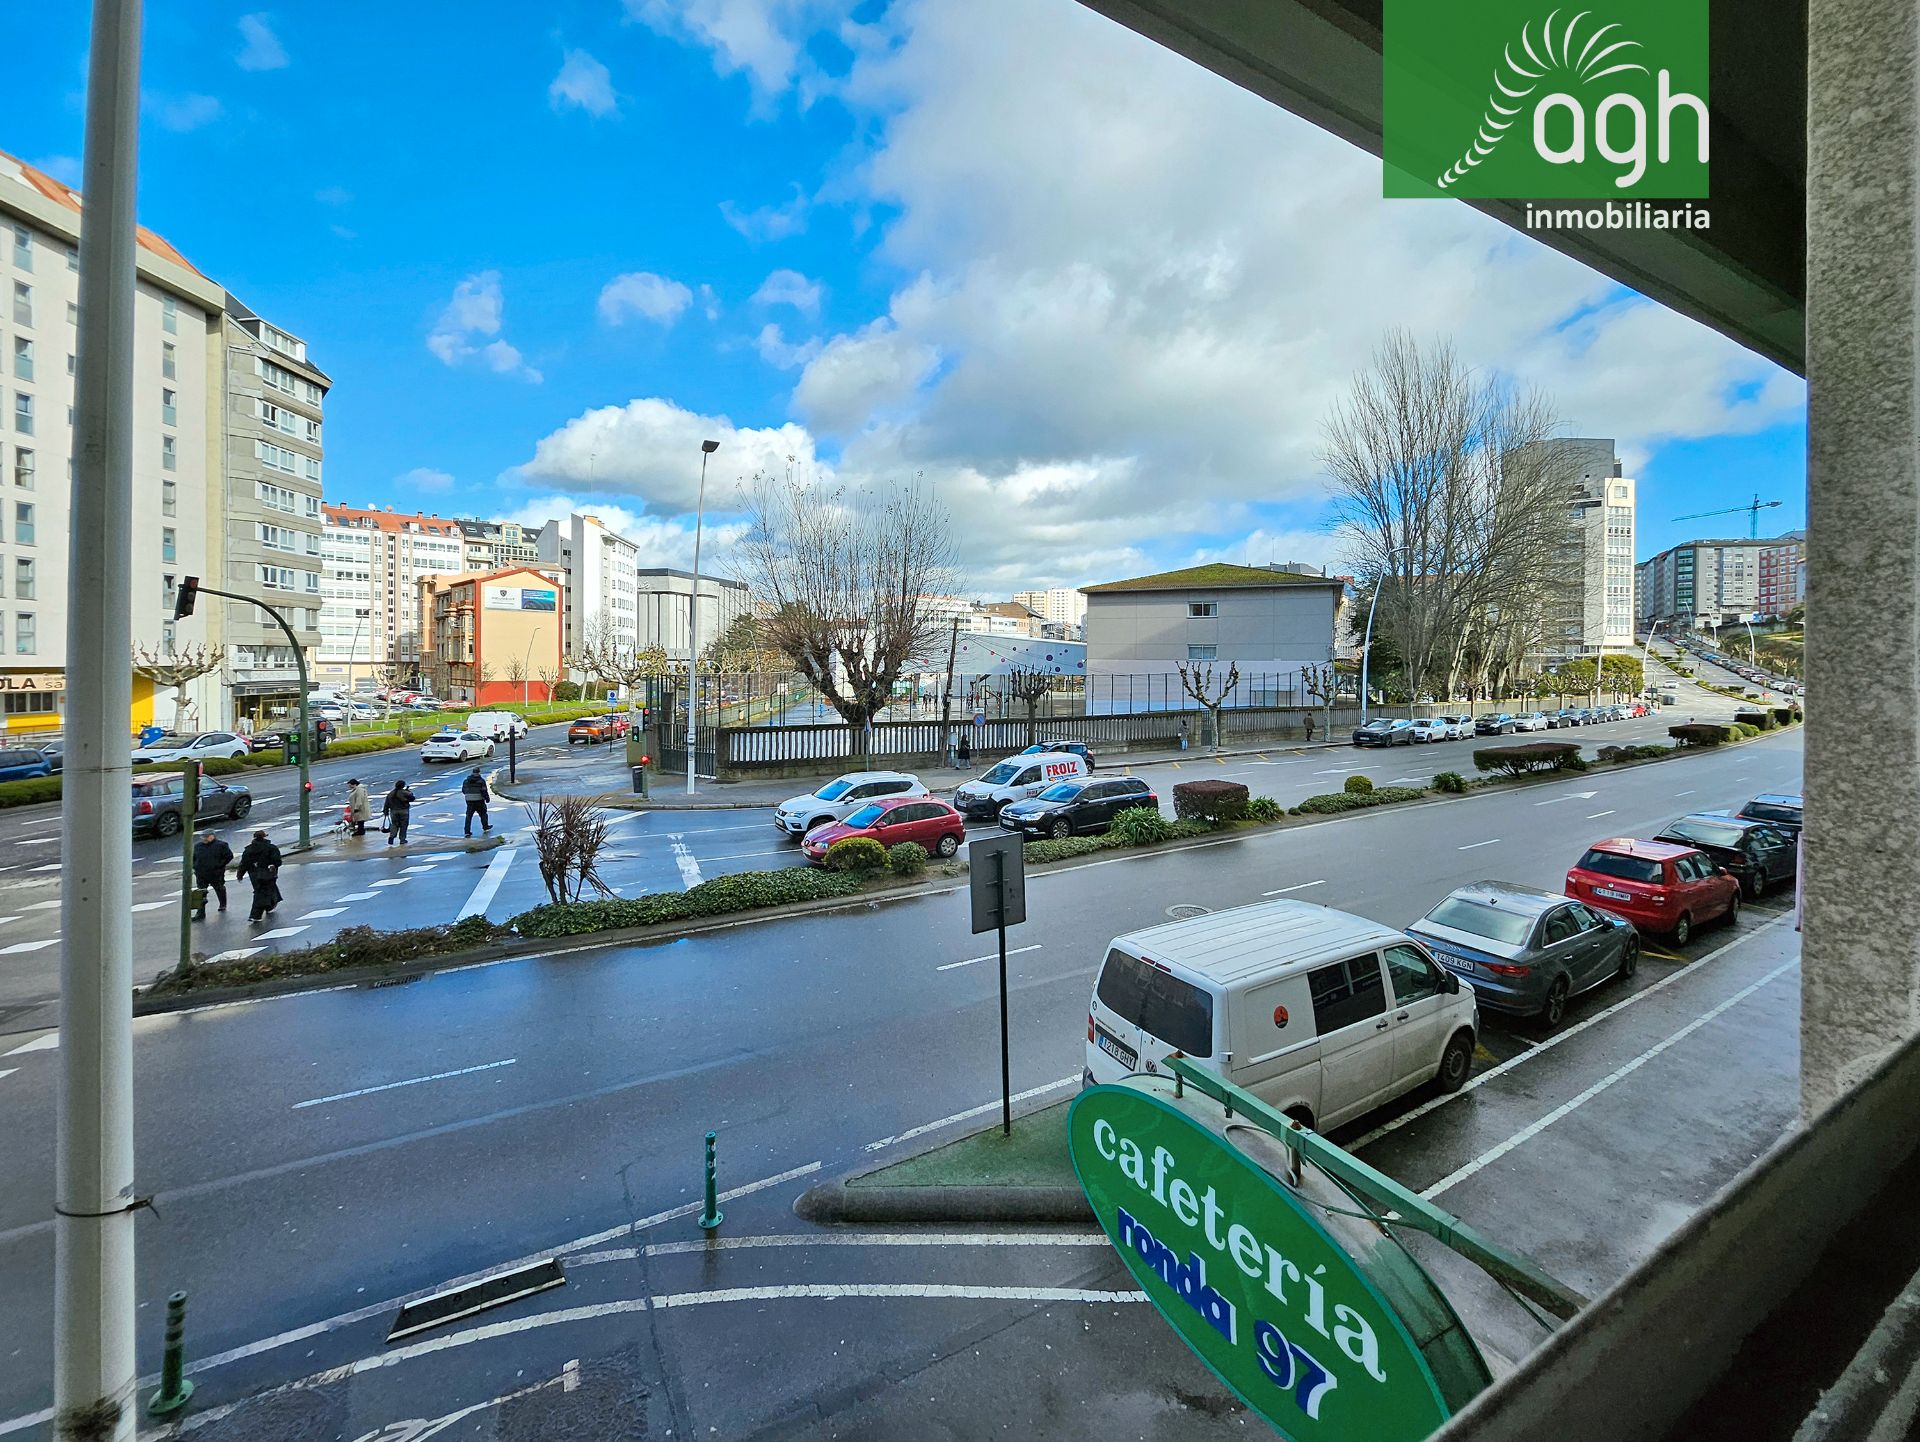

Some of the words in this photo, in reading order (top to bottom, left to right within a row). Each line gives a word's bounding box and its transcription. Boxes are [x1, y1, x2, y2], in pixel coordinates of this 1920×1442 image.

[1045, 761, 1078, 777] FROIZ
[1436, 953, 1455, 965] 1409
[1456, 958, 1473, 970] KGN
[1103, 1038, 1119, 1057] 1218
[1119, 1051, 1134, 1067] GHY
[1093, 1118, 1387, 1383] cafetería
[1117, 1206, 1237, 1345] ronda
[1254, 1319, 1338, 1421] 97
